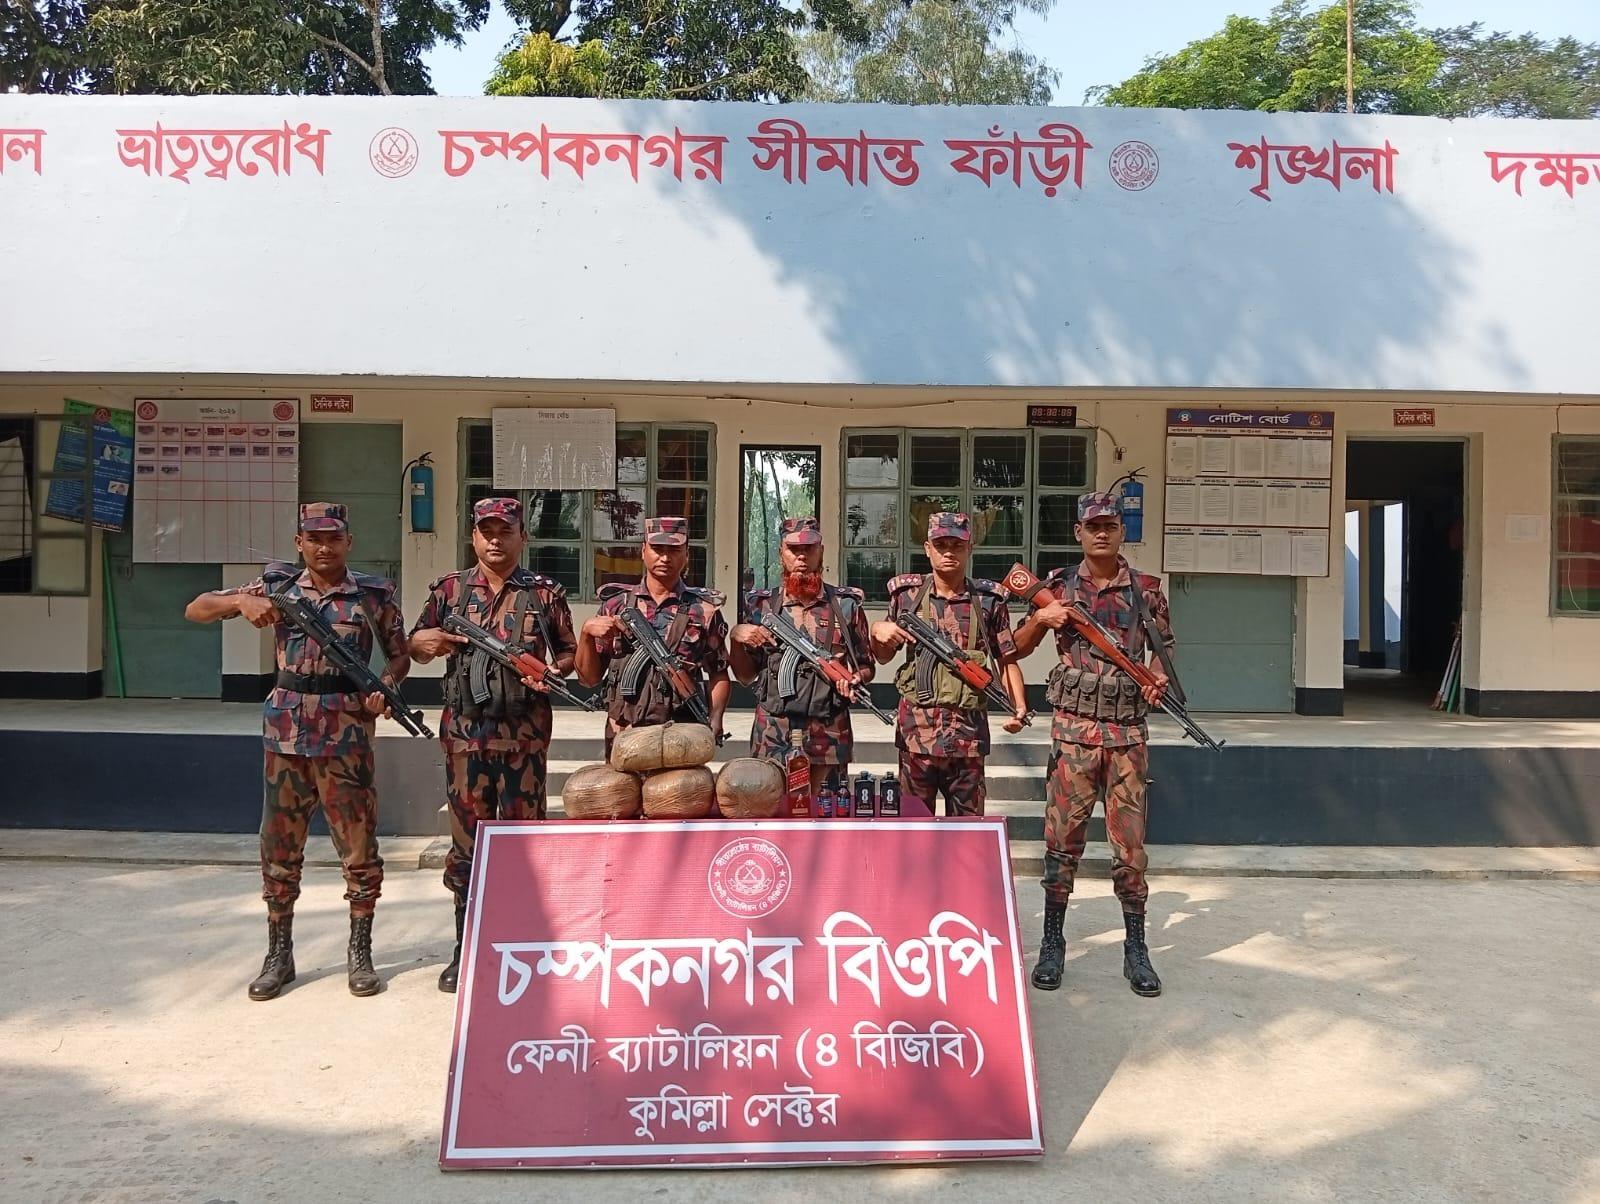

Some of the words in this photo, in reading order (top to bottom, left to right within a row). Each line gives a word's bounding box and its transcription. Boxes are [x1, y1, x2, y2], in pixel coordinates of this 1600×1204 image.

[0, 128, 47, 176] ল
[438, 123, 727, 184] চম্পকনগর
[747, 118, 924, 187] সীমান্ত
[1226, 135, 1400, 202] শৃঙ্খলা
[1483, 151, 1600, 199] দক্ষ
[1208, 412, 1253, 424] নোটিশ
[1258, 413, 1292, 425] বোর্ড
[492, 927, 803, 1009] চম্পকনগর
[815, 911, 1002, 1008] বিওপি
[507, 1024, 596, 1074] ফেনী
[604, 1022, 783, 1073] ব্যাটালিয়ন
[795, 1027, 839, 1079] (৪
[850, 1020, 986, 1078] বিজিবি)
[626, 1084, 732, 1141] কুমিল্লা
[743, 1082, 841, 1128] সেক্টর
